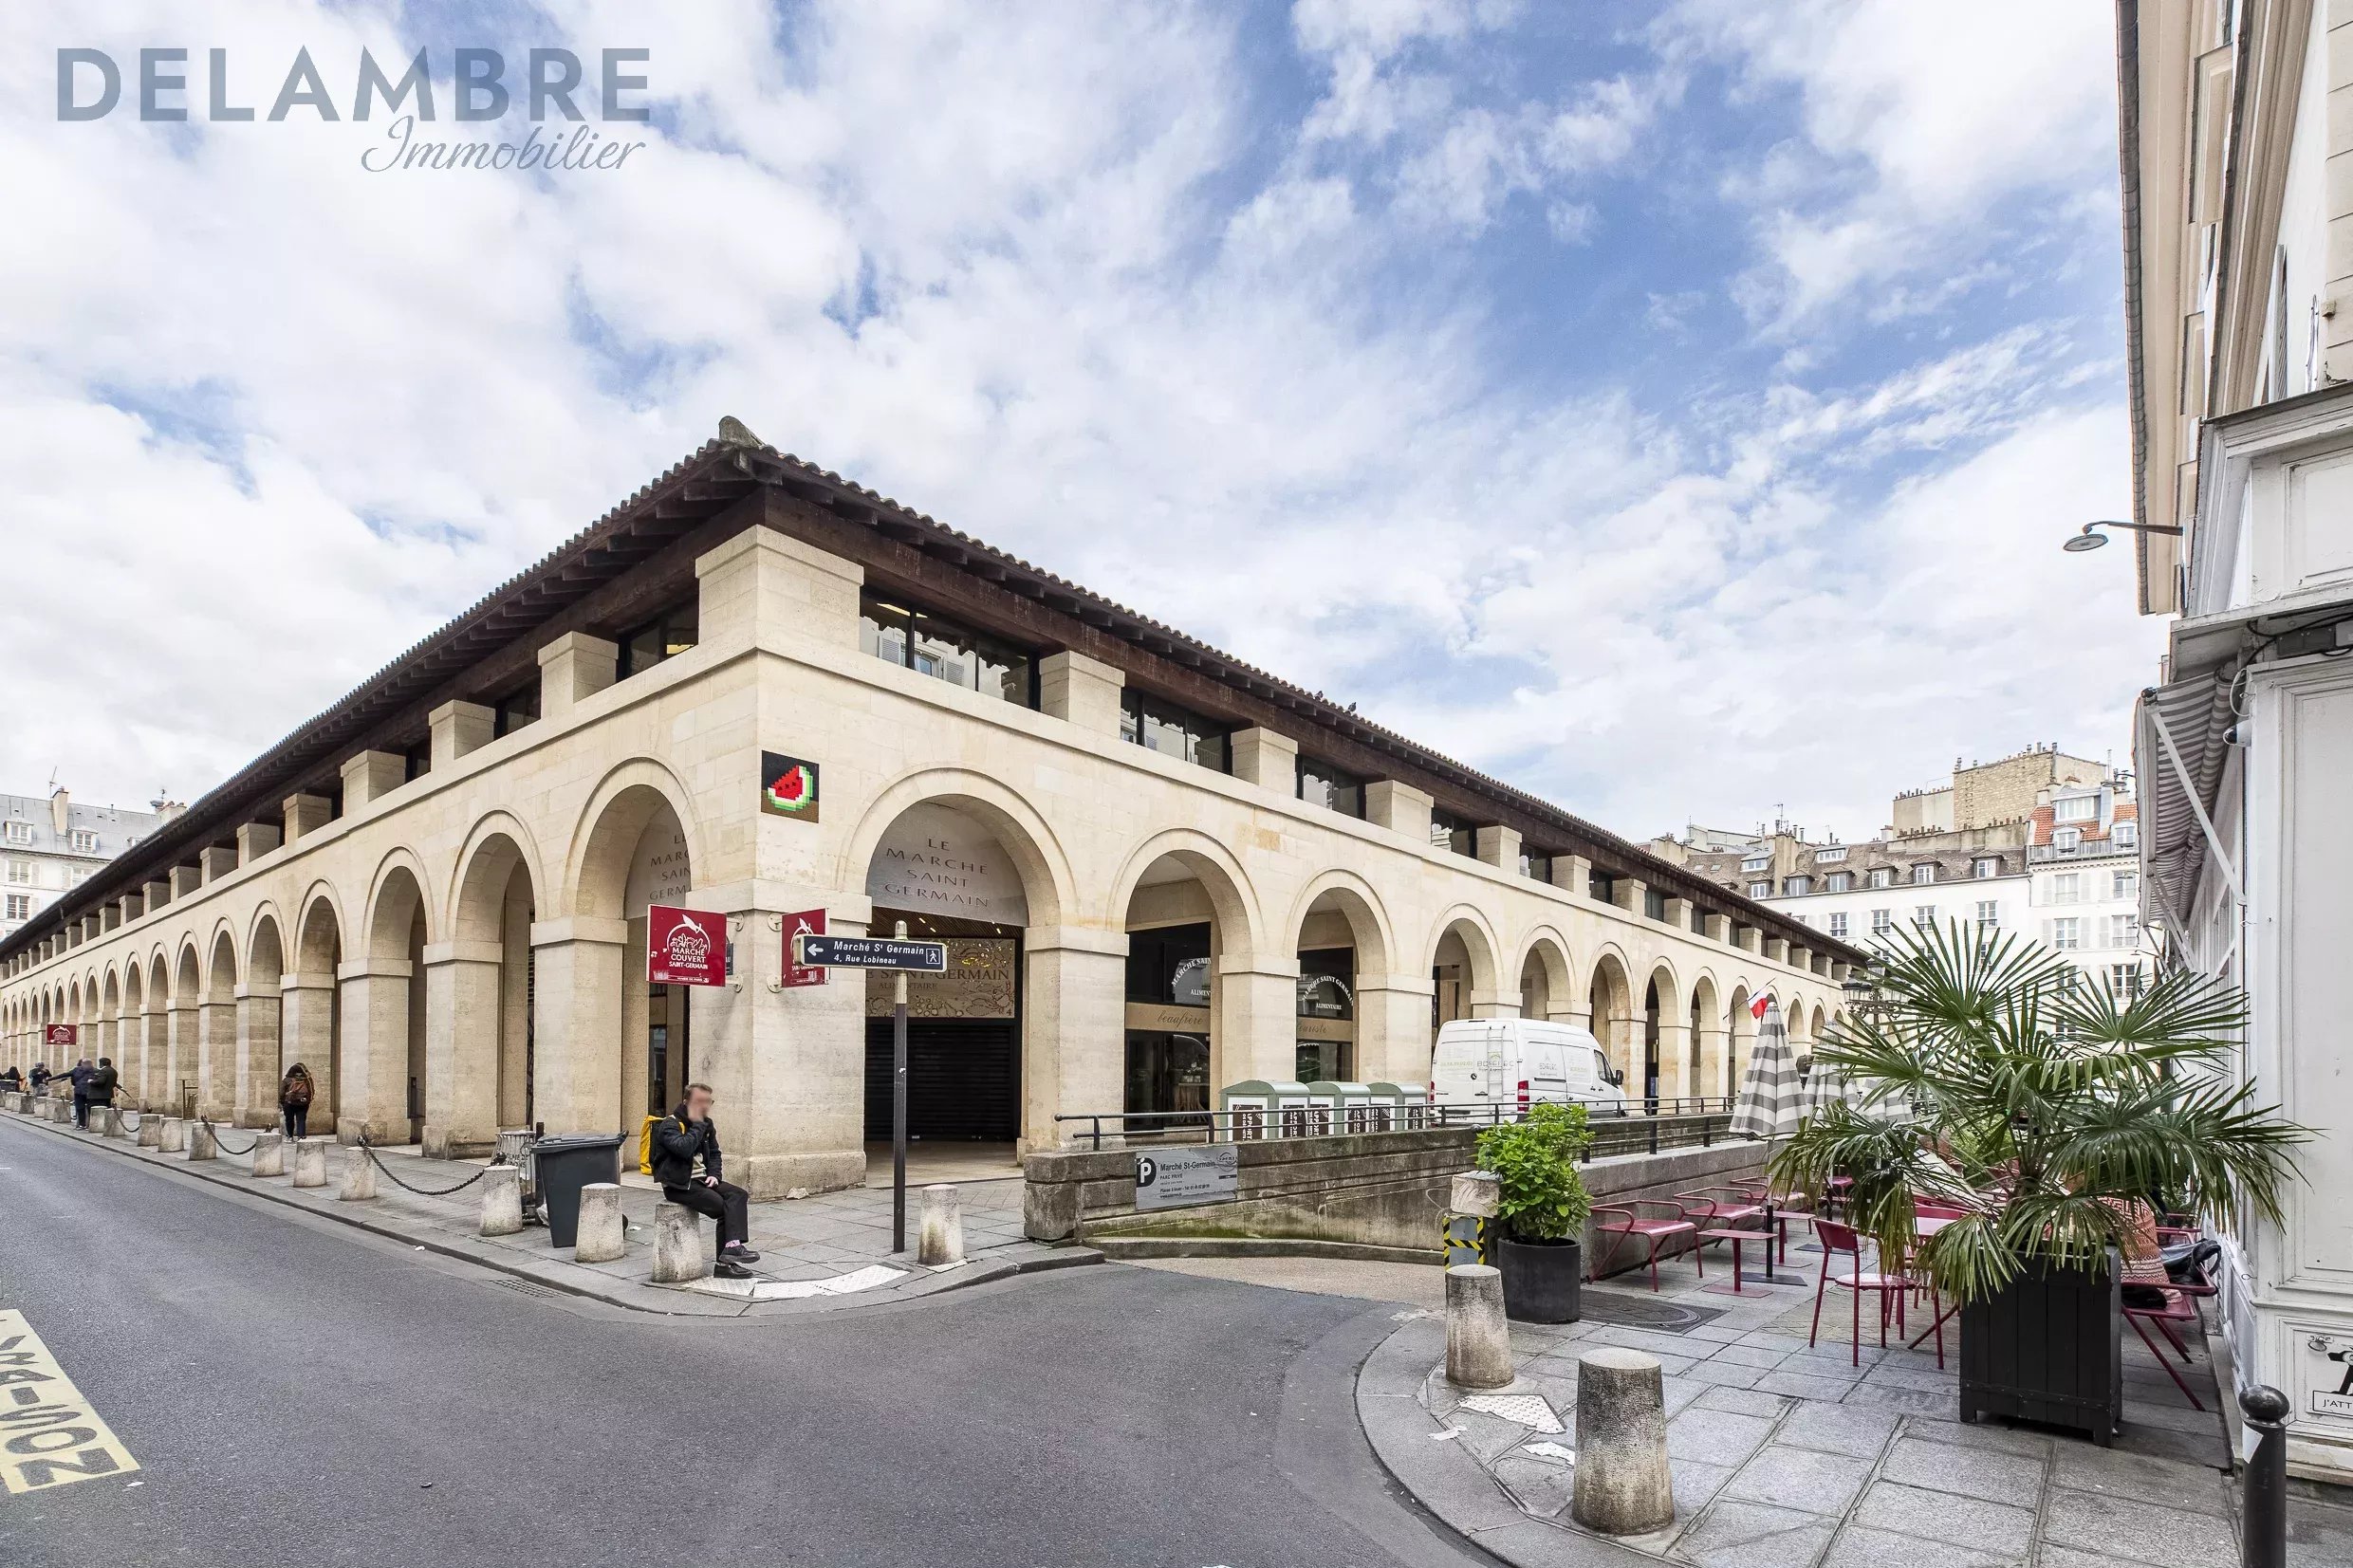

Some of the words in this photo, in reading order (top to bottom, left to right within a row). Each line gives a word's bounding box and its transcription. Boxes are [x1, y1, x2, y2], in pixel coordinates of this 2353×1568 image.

[928, 838, 950, 851] LE
[886, 847, 988, 875] MARCHE
[907, 869, 969, 888] SAINT
[884, 883, 989, 908] GERMAIN
[833, 940, 870, 952] Marché
[886, 945, 924, 955] Germain
[670, 953, 706, 963] COUVERT
[845, 954, 861, 963] Rue
[862, 955, 897, 965] Lobineau
[668, 961, 709, 969] SAINT-GERMAIN
[1159, 1162, 1183, 1171] Marché
[1183, 1160, 1215, 1170] St-Germain
[2323, 1398, 2353, 1410] J'ATT
